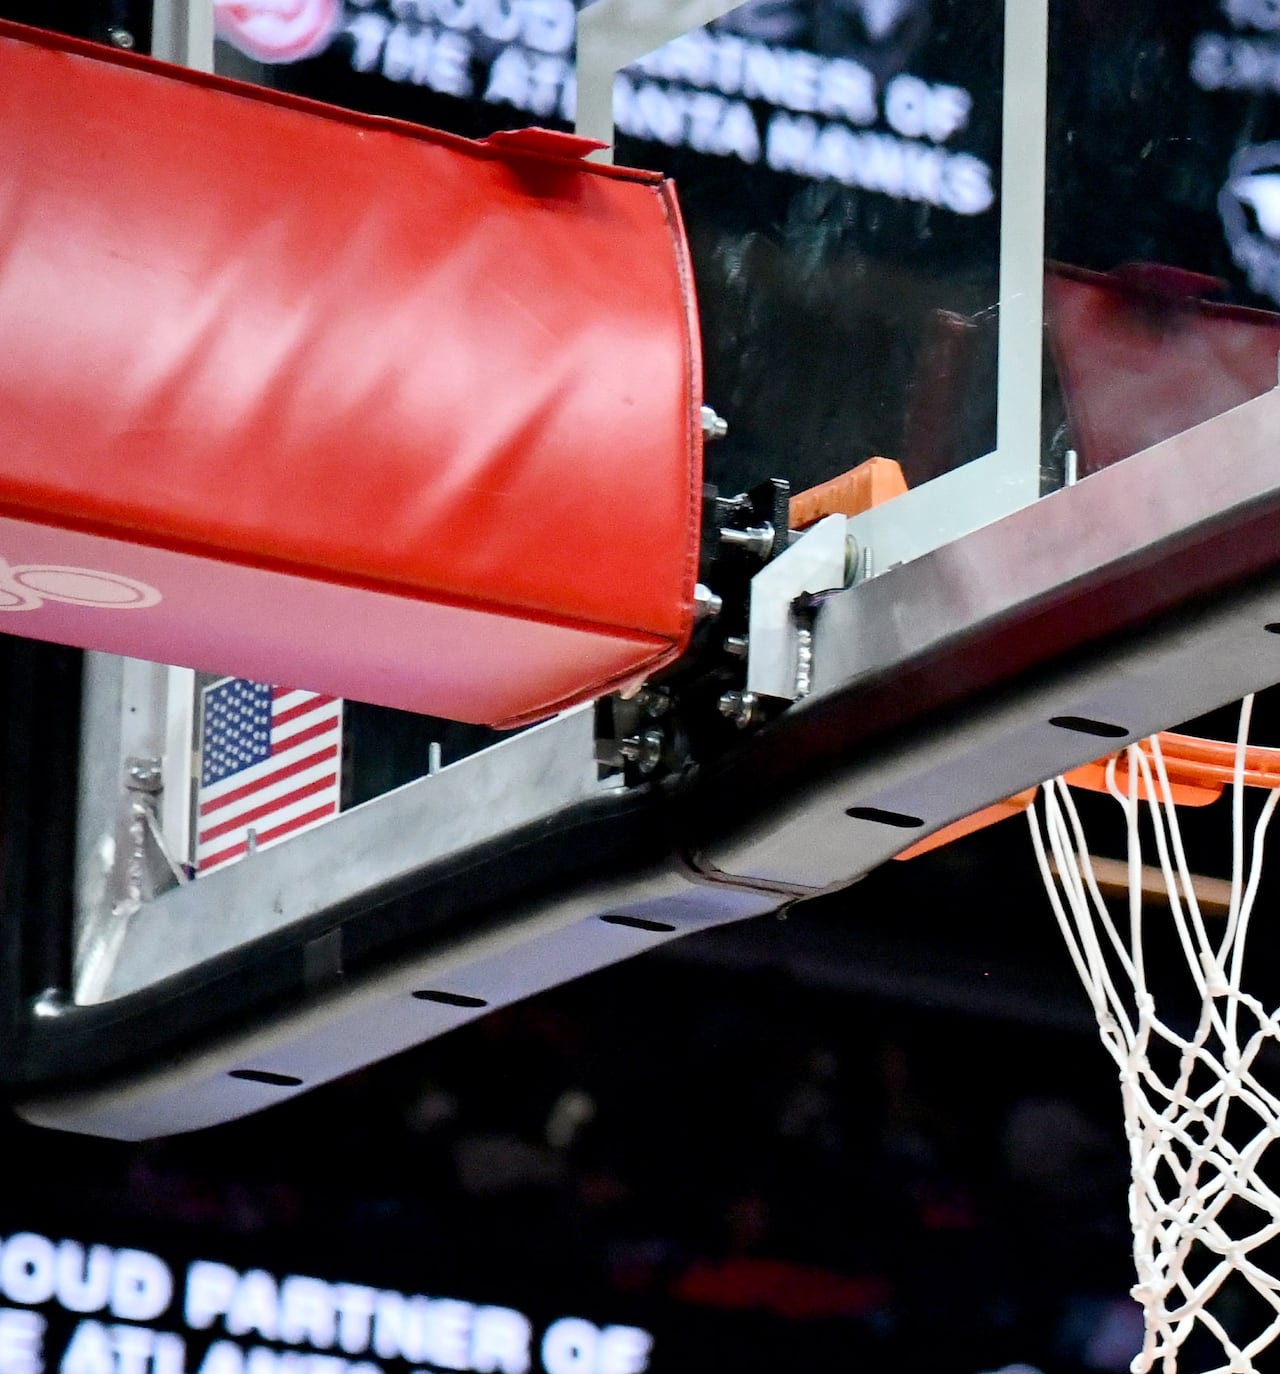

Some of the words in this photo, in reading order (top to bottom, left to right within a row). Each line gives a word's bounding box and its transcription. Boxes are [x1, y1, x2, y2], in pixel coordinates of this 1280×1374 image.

[345, 11, 473, 98] THE
[766, 110, 994, 216] HAWKS
[886, 72, 973, 143] OF
